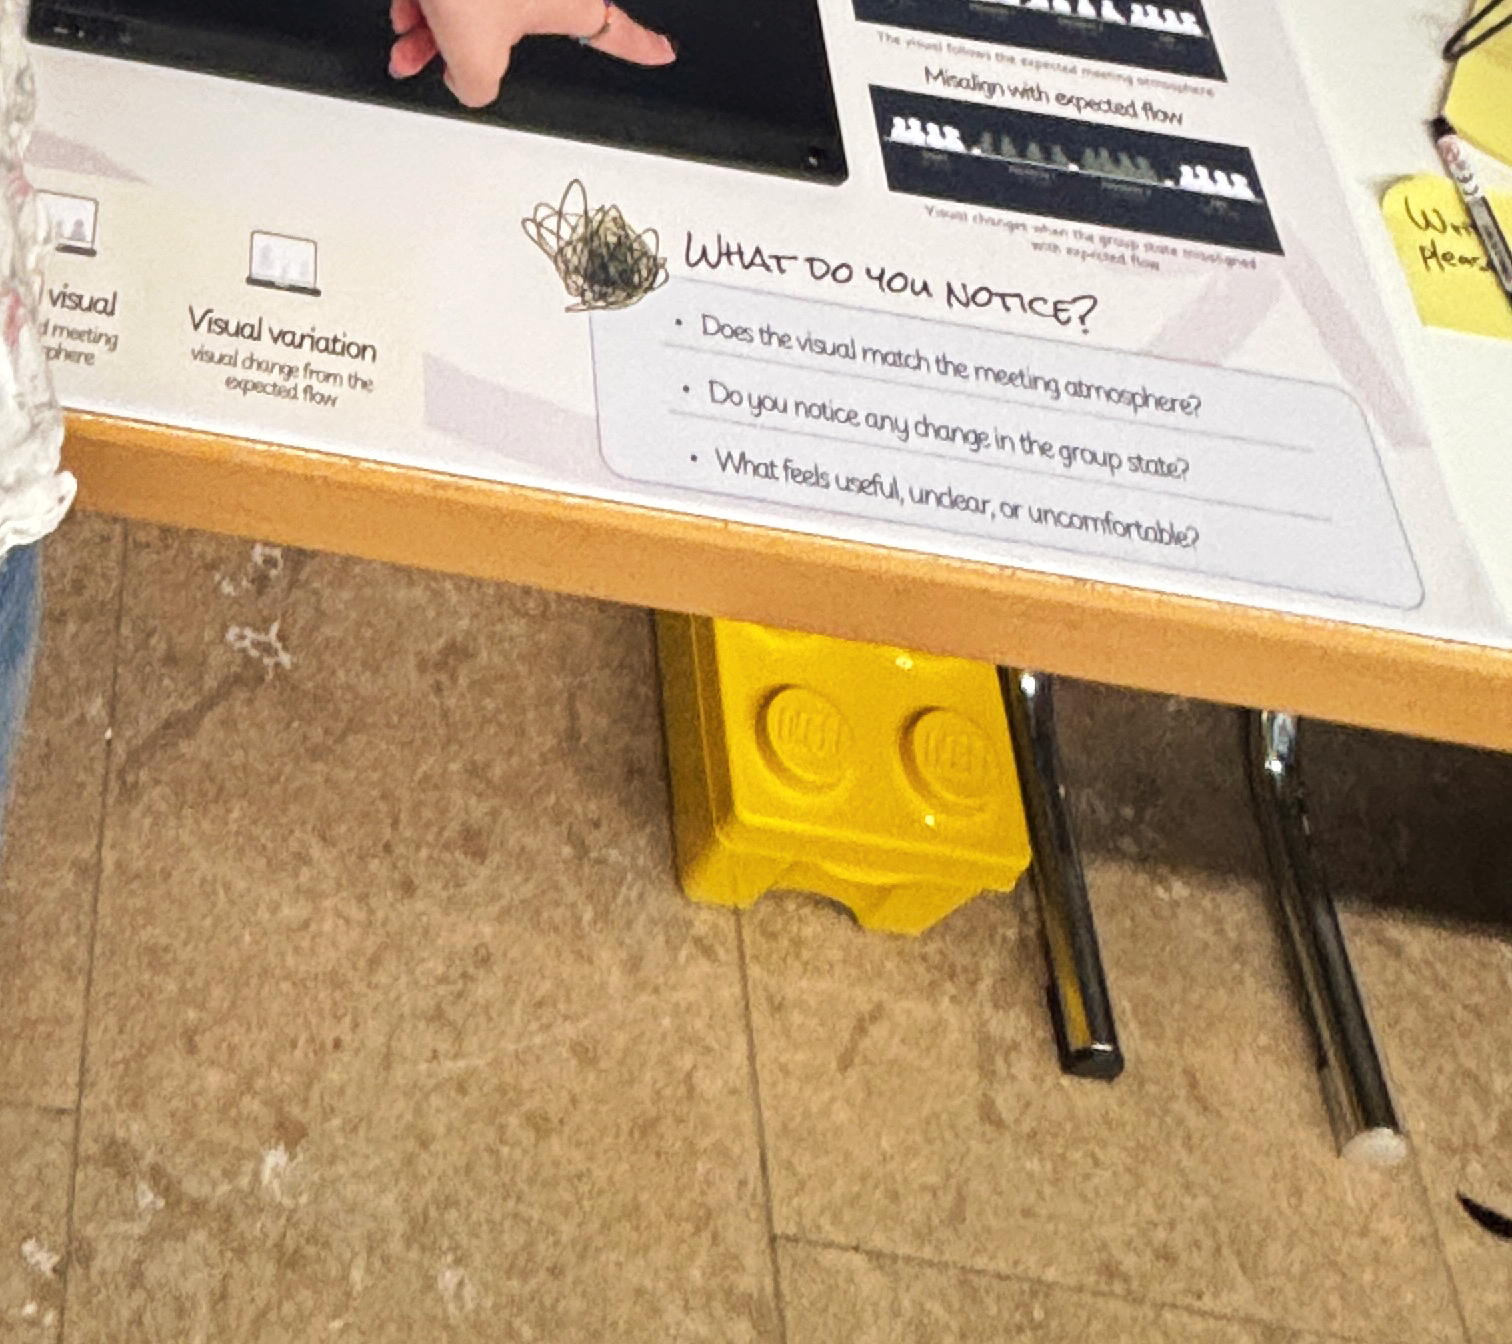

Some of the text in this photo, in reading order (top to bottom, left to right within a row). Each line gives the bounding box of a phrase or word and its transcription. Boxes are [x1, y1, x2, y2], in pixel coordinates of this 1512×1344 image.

[924, 66, 1183, 125] Misalign with expected flow
[49, 283, 118, 316] visual
[685, 230, 798, 274] WHAT
[804, 257, 853, 284] DO
[947, 281, 1097, 334] NOTICE?
[189, 304, 377, 363] Visual variation
[191, 345, 374, 393] visual change from the
[225, 373, 338, 408] expected flow
[702, 313, 1201, 417] Does the visual match the meeting atmosphere?
[709, 379, 1189, 481] Do you notice any change in the group state?
[715, 448, 1199, 550] What feels useful, unclear, or uncomfortable?
